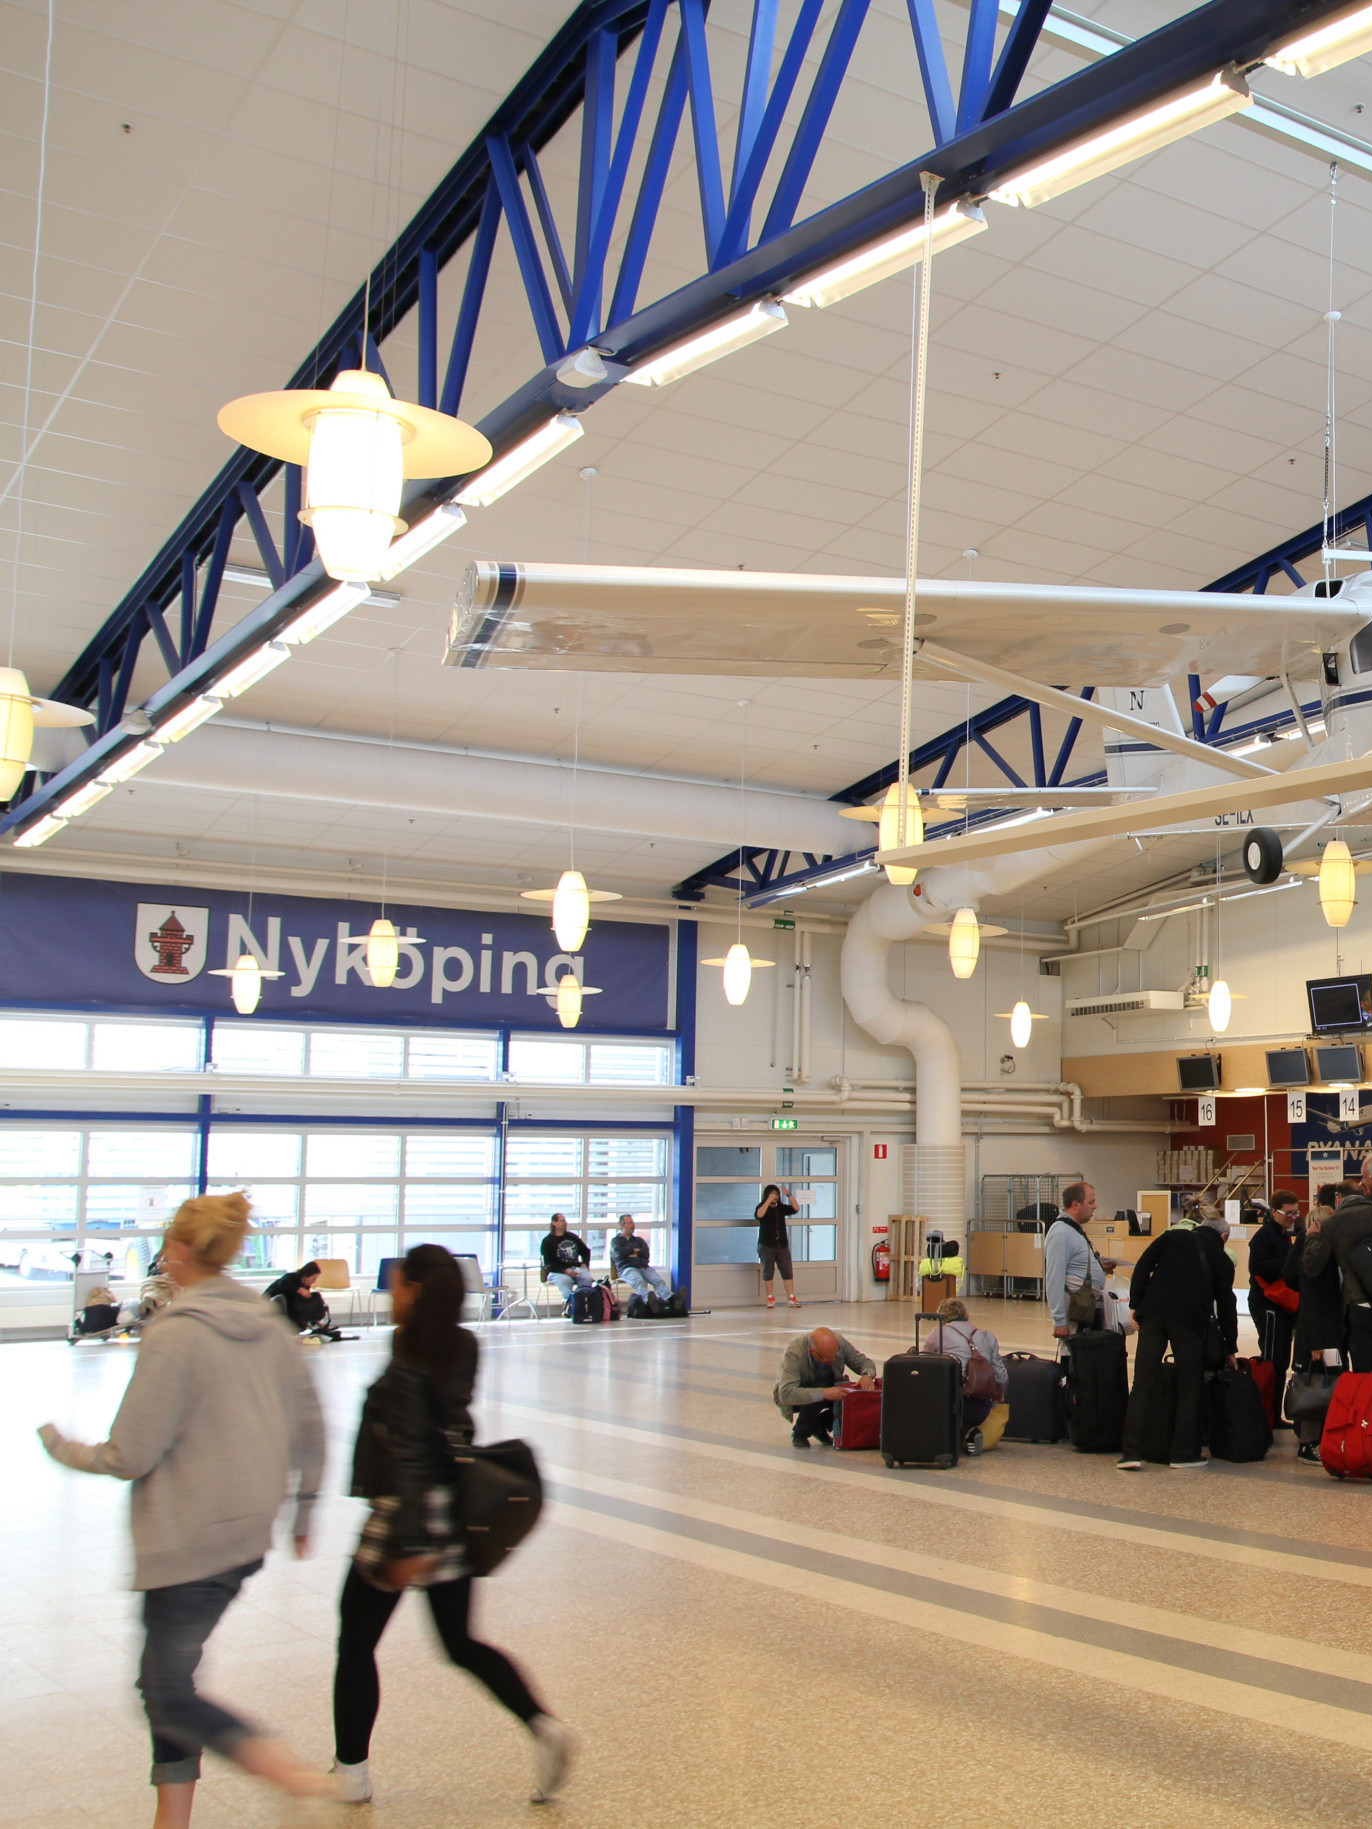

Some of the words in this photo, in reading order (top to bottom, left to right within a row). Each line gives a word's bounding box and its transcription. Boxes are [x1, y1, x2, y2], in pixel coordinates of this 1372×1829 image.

[1200, 1104, 1213, 1122] 16
[1290, 1100, 1303, 1119] 15
[1342, 1097, 1355, 1117] 14
